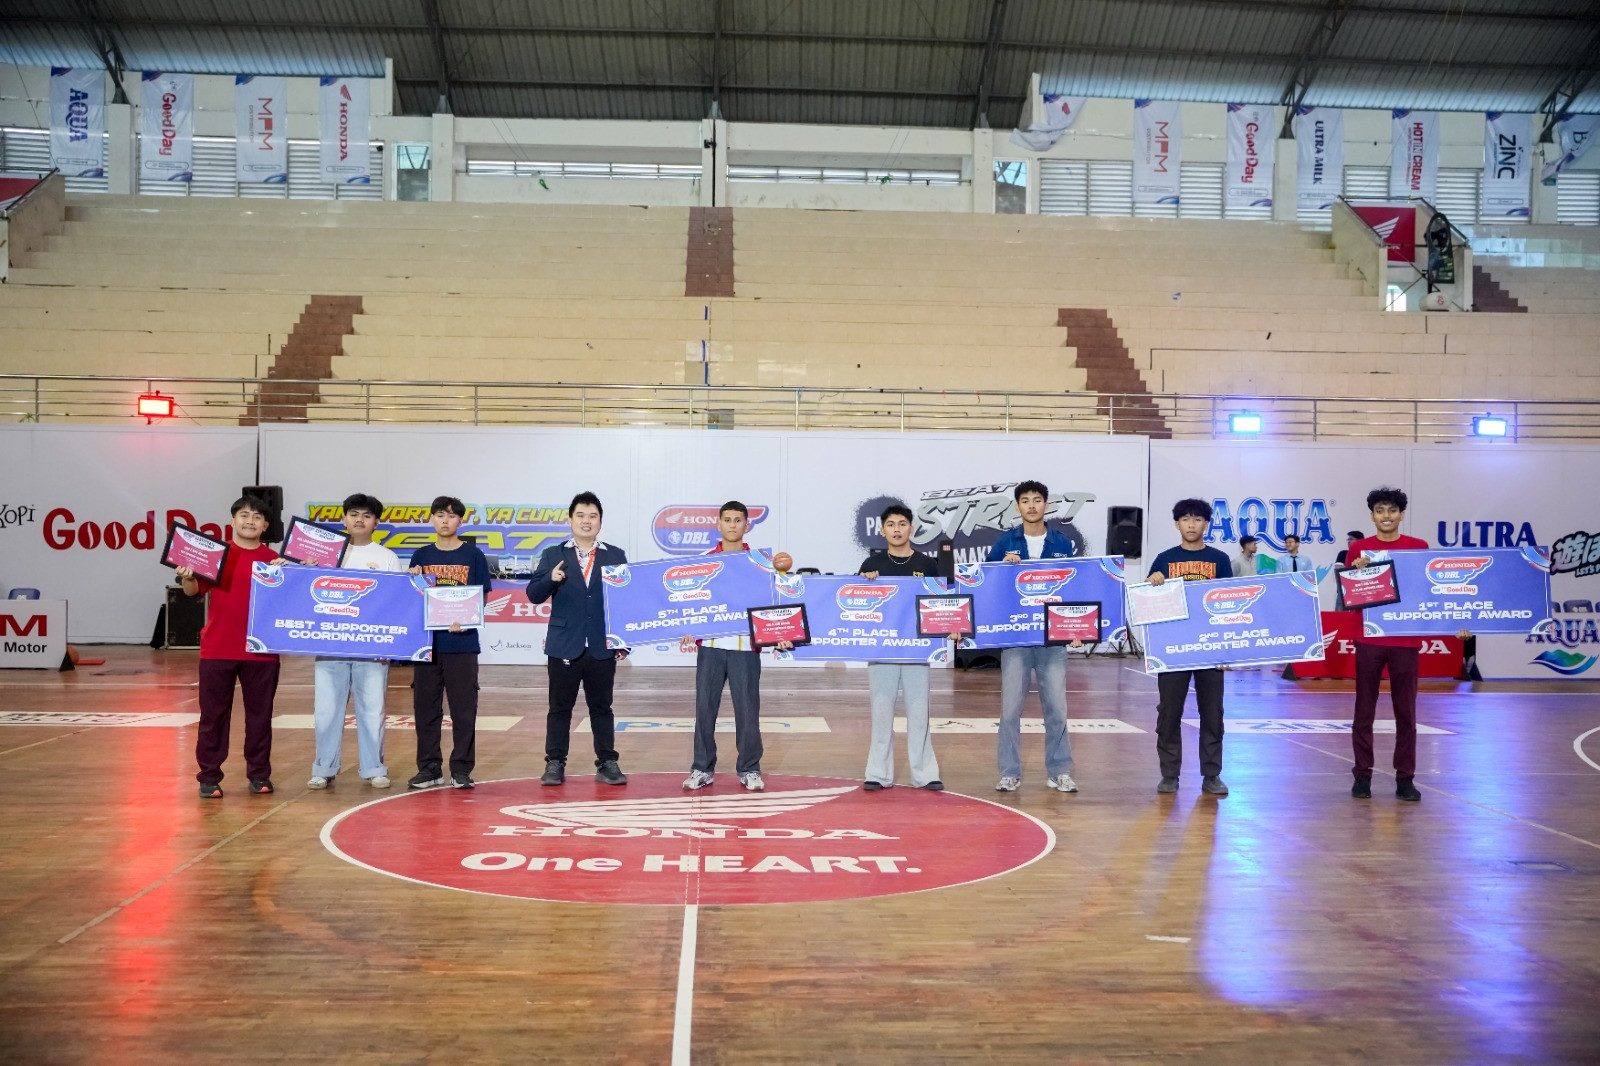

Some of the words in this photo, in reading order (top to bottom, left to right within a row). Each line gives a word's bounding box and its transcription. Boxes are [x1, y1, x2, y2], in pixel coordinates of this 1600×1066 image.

[66, 88, 89, 143] AQUA
[162, 93, 177, 127] Good
[258, 98, 273, 151] MPM
[339, 102, 348, 161] HONDA
[159, 129, 176, 156] Day
[1245, 122, 1259, 156] Good
[1314, 120, 1324, 154] ULTRA
[1154, 121, 1169, 173] MPM
[1497, 134, 1522, 179] ZINC
[1241, 157, 1259, 184] Day
[1313, 157, 1324, 185] MILK
[1410, 155, 1423, 191] CREAM
[486, 507, 515, 524] YA
[683, 516, 720, 524] HON
[1203, 497, 1336, 553] AQUA
[43, 508, 155, 550] Good
[682, 532, 710, 544] DBL
[1438, 521, 1537, 547] ULTRA
[954, 546, 991, 563] MAK
[658, 609, 678, 618] 5TH
[682, 604, 727, 616] PLACE
[1382, 610, 1472, 620] SUPPORTER
[1478, 610, 1532, 619] AWARD
[1419, 602, 1438, 610] 1ST
[1444, 601, 1493, 610] PLACE
[275, 619, 315, 629] BEST
[320, 621, 408, 635] SUPPORTER
[625, 616, 707, 631] SUPPORTER
[713, 611, 748, 622] AWA
[977, 622, 1045, 633] SUPPORT
[1010, 614, 1028, 622] 3RD
[288, 630, 395, 643] COORDINATOR
[811, 637, 877, 647] PPORTER
[882, 637, 931, 647] AWARD
[828, 628, 849, 637] 4TH
[852, 629, 898, 637] PLACE
[1199, 632, 1219, 642] 2ND
[1223, 629, 1270, 640] PLACE
[4, 642, 47, 653] Motor
[1166, 640, 1250, 654] SUPPORTER
[1255, 635, 1306, 647] AWARD
[482, 826, 900, 840] HONDA
[461, 852, 623, 871] One
[642, 854, 922, 873] HEART.
